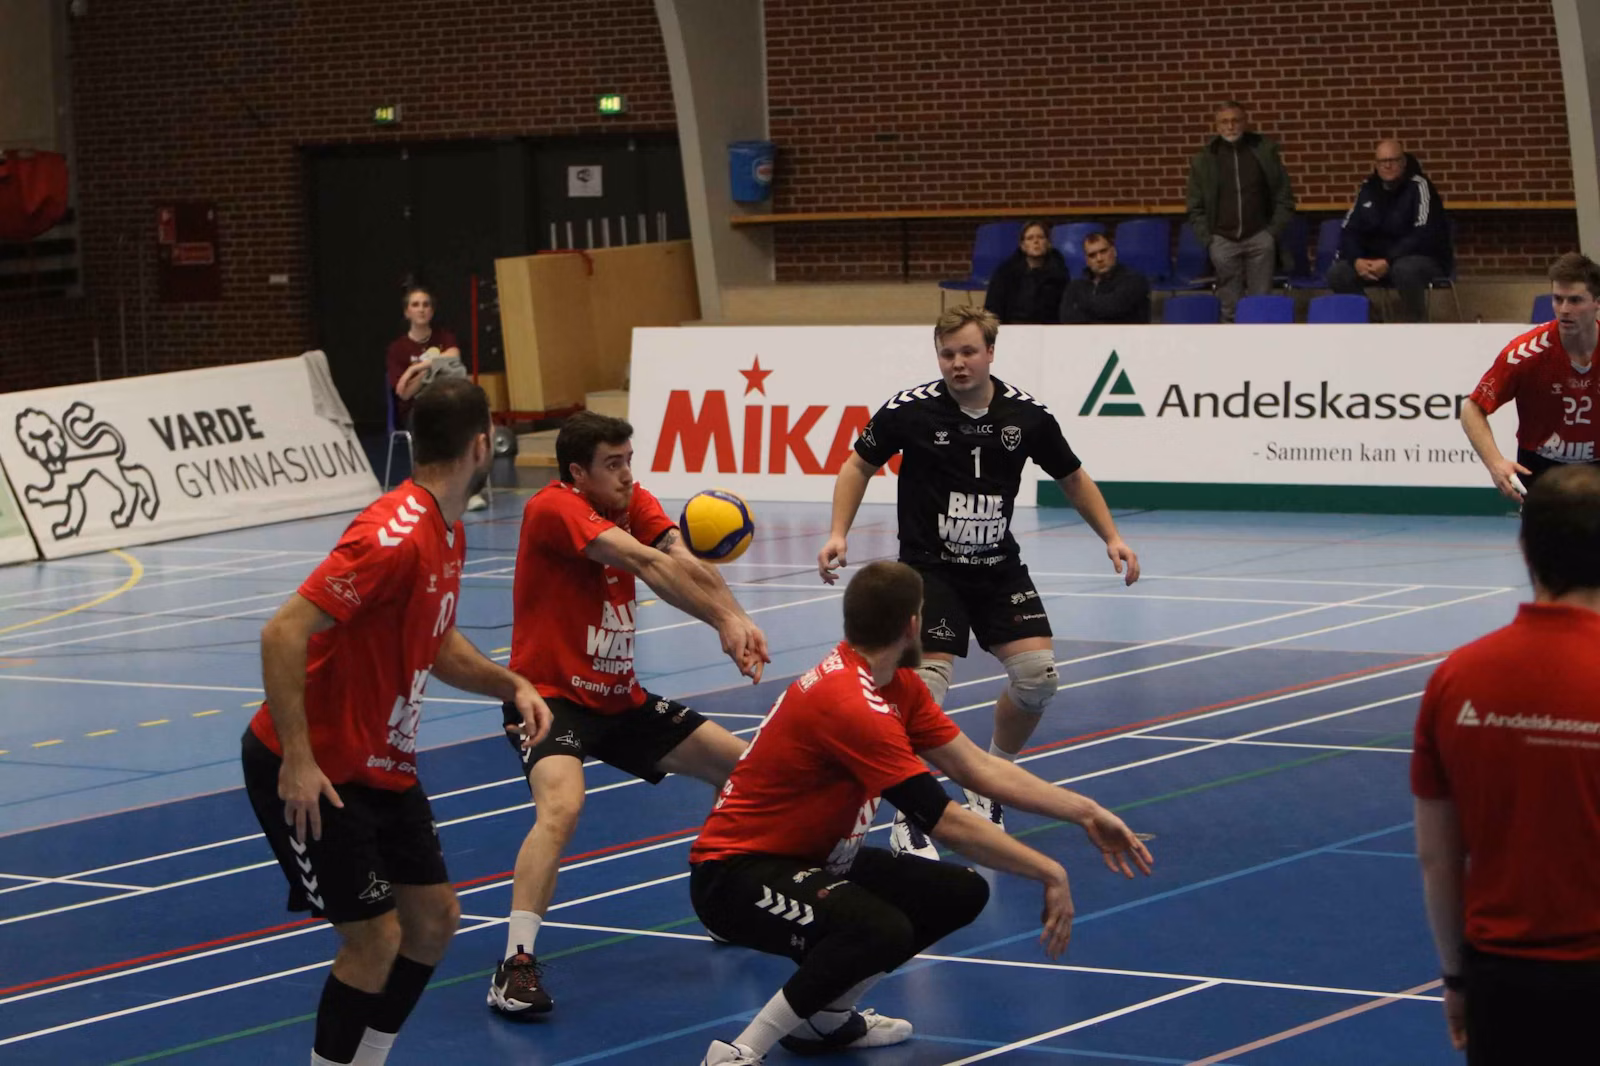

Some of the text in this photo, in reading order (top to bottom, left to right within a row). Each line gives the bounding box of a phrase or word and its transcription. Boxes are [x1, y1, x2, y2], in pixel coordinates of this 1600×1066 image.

[148, 405, 265, 451] VARDE
[651, 388, 903, 476] MIKA
[976, 424, 994, 434] LCC
[970, 446, 981, 479] 1
[1266, 441, 1353, 462] Sammen
[1359, 443, 1397, 463] kan
[1403, 444, 1421, 464] vi
[175, 439, 367, 499] GYMNASIUM
[948, 491, 1004, 519] BLUE
[938, 513, 1008, 545] WATER
[571, 675, 610, 696] Granly
